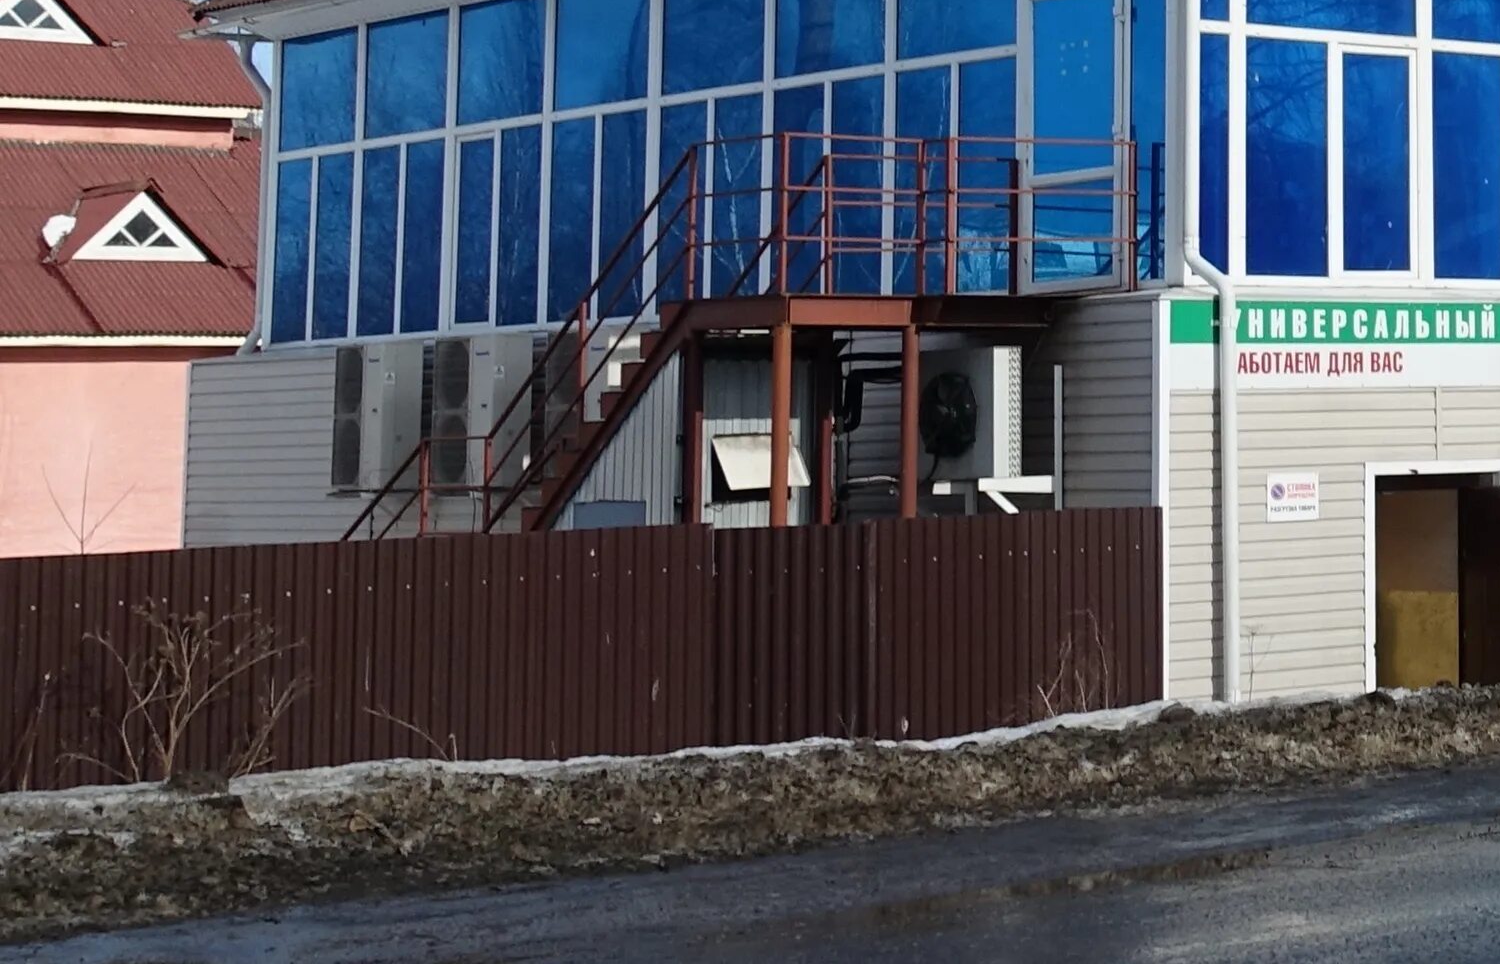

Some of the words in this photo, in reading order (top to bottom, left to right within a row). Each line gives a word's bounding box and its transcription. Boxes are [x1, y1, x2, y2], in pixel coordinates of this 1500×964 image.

[1237, 352, 1320, 374] АБОТАЕМ
[1327, 352, 1363, 377] ДЛЯ
[1370, 351, 1403, 373] ВАС
